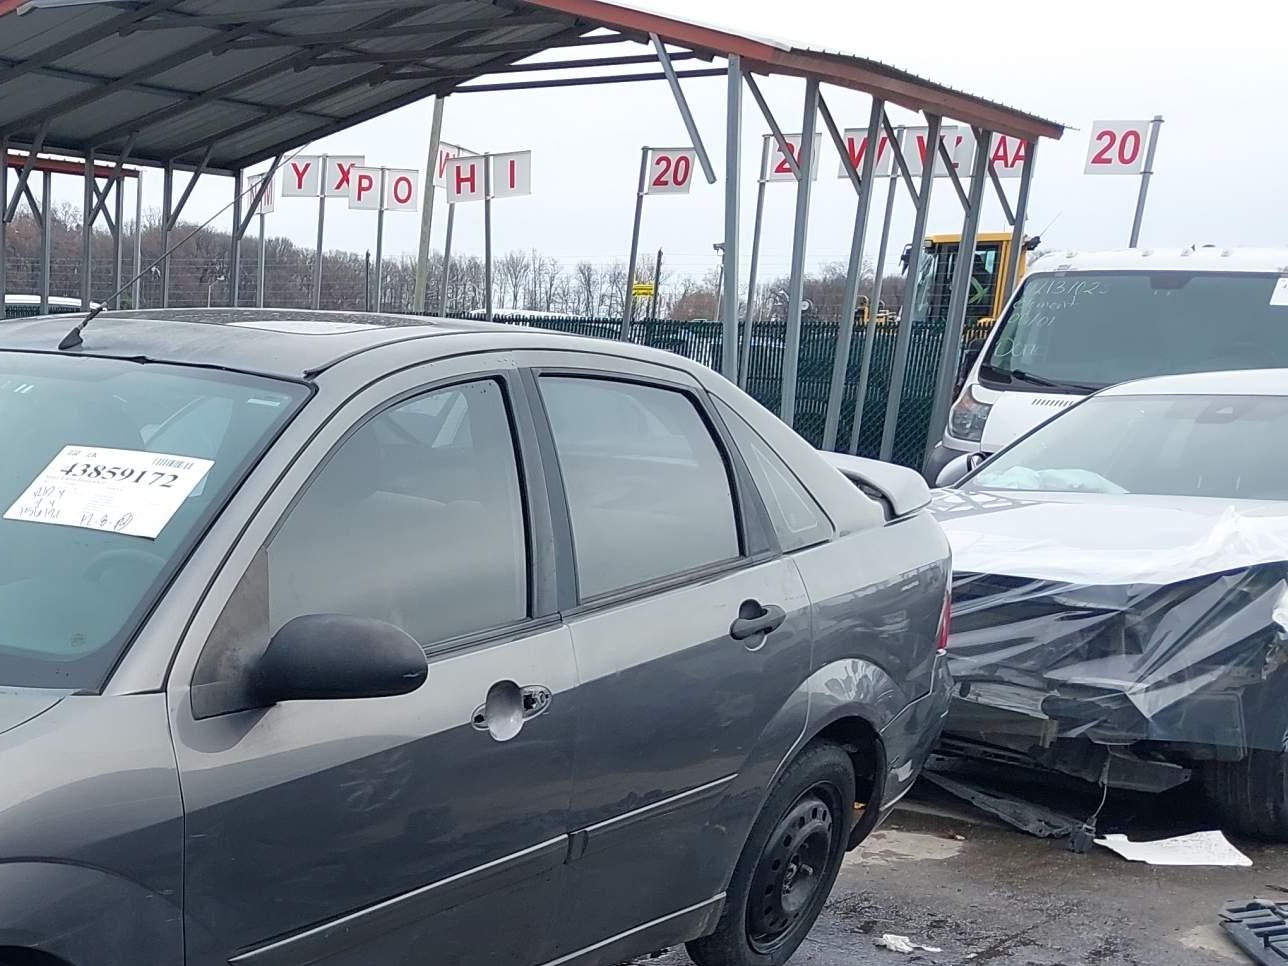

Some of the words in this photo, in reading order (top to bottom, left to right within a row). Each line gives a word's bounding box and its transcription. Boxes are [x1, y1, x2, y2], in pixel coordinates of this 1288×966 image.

[1091, 130, 1141, 165] 20
[291, 163, 311, 190] Y
[334, 163, 356, 190] X
[455, 164, 476, 194] H
[509, 159, 515, 189] I
[652, 155, 690, 187] 20
[356, 174, 373, 201] P
[393, 176, 413, 204] O
[59, 462, 179, 488] 43859172
